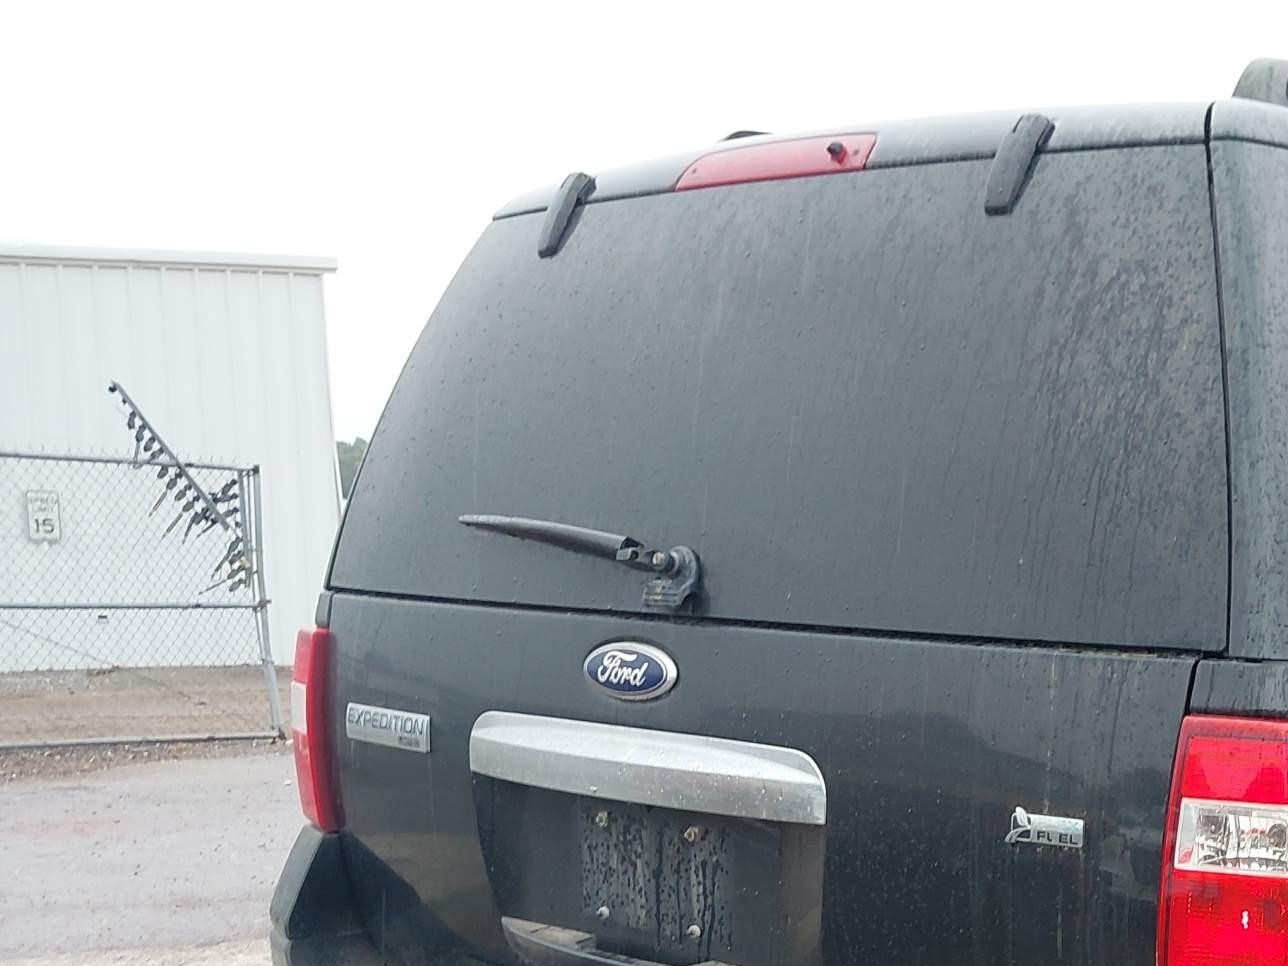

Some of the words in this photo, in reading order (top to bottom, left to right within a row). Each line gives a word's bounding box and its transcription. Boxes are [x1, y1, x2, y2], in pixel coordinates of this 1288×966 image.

[34, 518, 55, 534] 15
[597, 650, 649, 687] Ford
[347, 707, 425, 735] EXPEDITION
